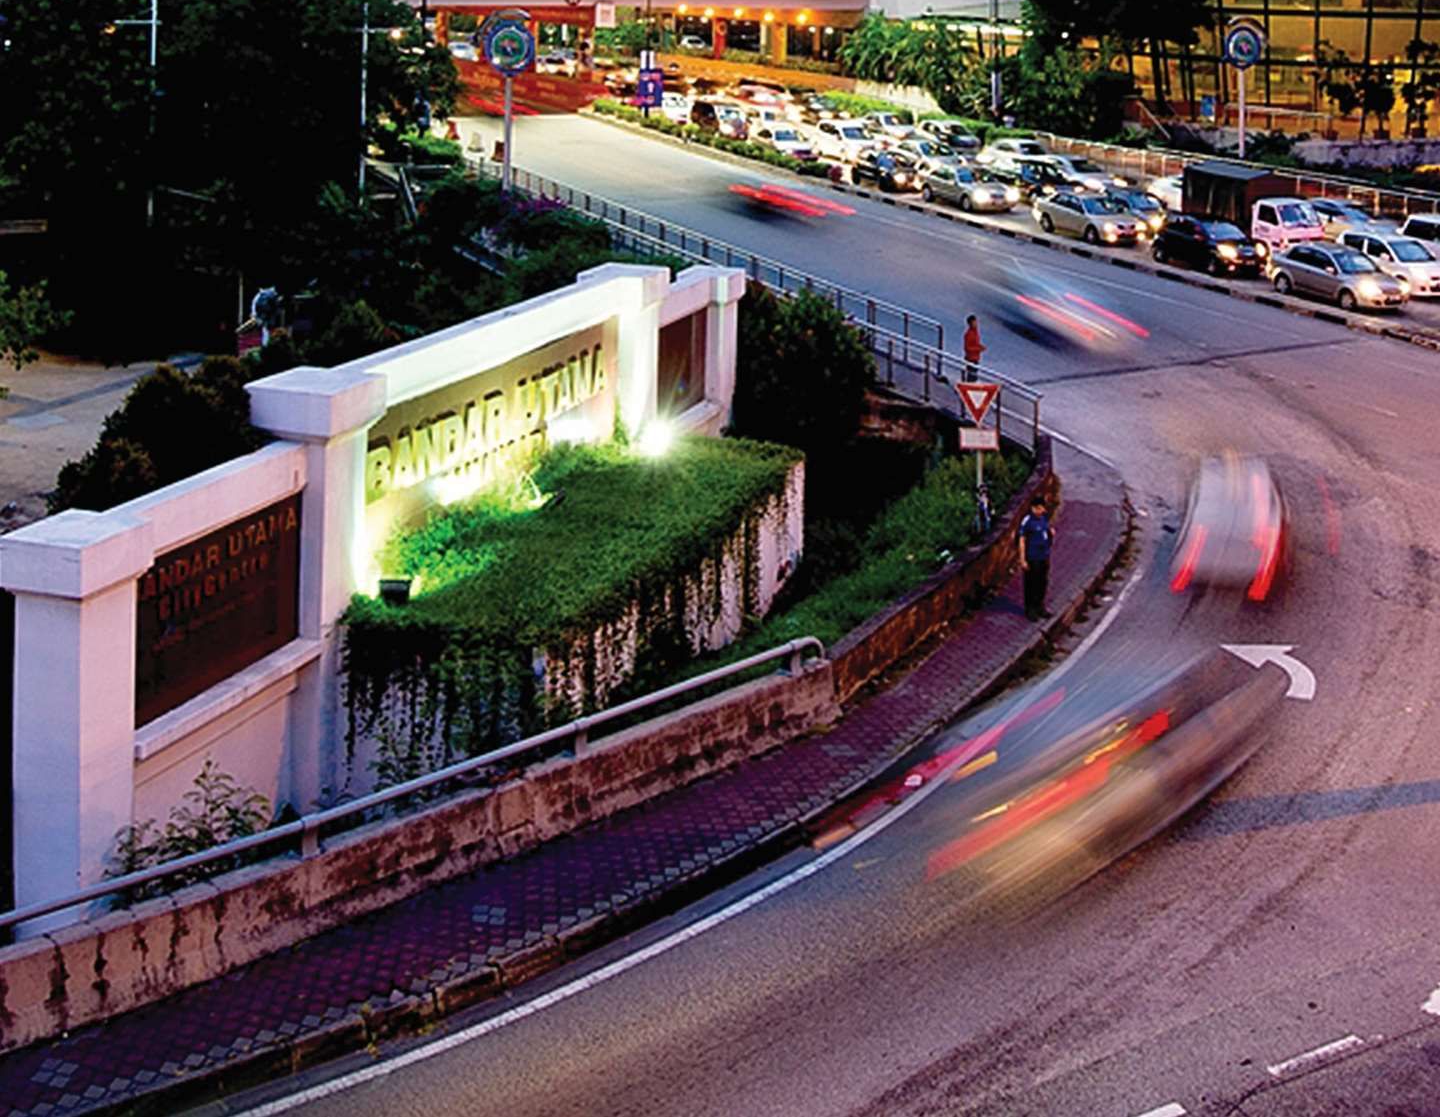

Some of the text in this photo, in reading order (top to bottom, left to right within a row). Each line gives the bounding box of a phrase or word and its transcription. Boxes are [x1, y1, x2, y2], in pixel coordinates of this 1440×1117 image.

[365, 389, 508, 505] BANDAR
[516, 343, 605, 428] UTAMA
[140, 544, 220, 601] ANDAR
